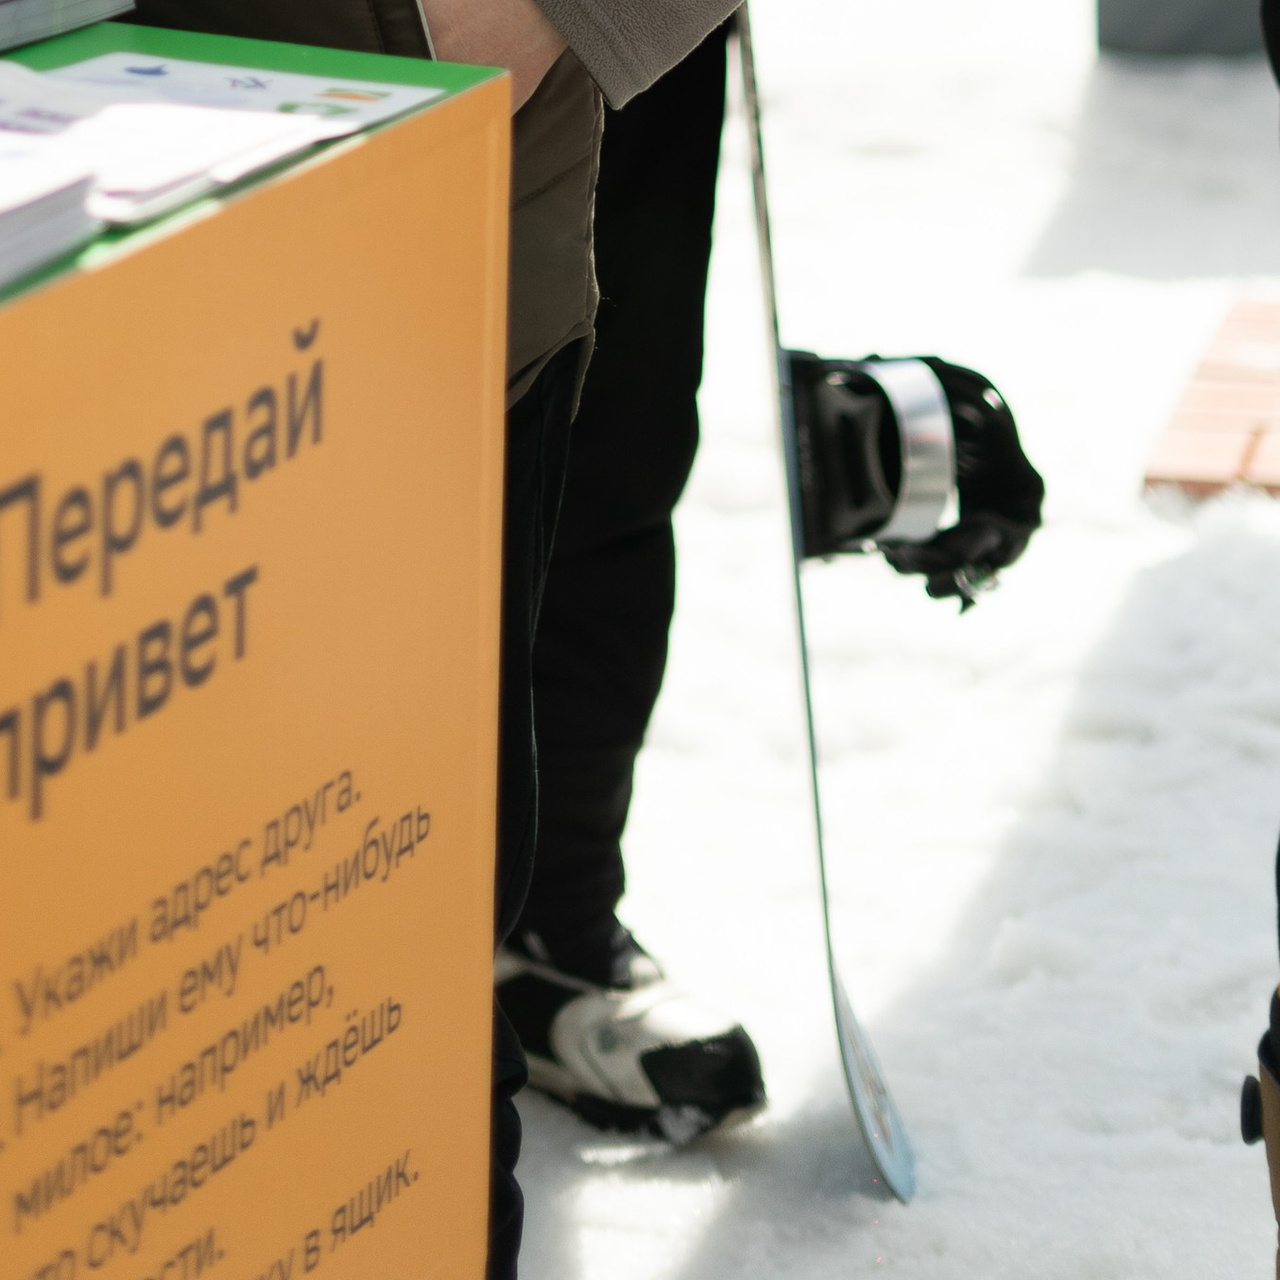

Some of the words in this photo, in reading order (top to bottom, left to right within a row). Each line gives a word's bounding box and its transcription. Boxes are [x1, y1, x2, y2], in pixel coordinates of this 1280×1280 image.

[12, 917, 140, 1037] Укажи
[148, 838, 253, 946] адрес
[260, 768, 363, 878] друга.
[14, 989, 168, 1137] Напиши
[177, 933, 243, 1015] ему
[252, 804, 432, 956] что-нибудь
[13, 1099, 144, 1236] милое:
[155, 963, 336, 1127] например,
[86, 1110, 257, 1270] скучаешь
[265, 1080, 287, 1131] и
[295, 994, 404, 1110] ждёшь
[304, 1228, 320, 1274] в
[329, 1149, 420, 1253] ящик.
